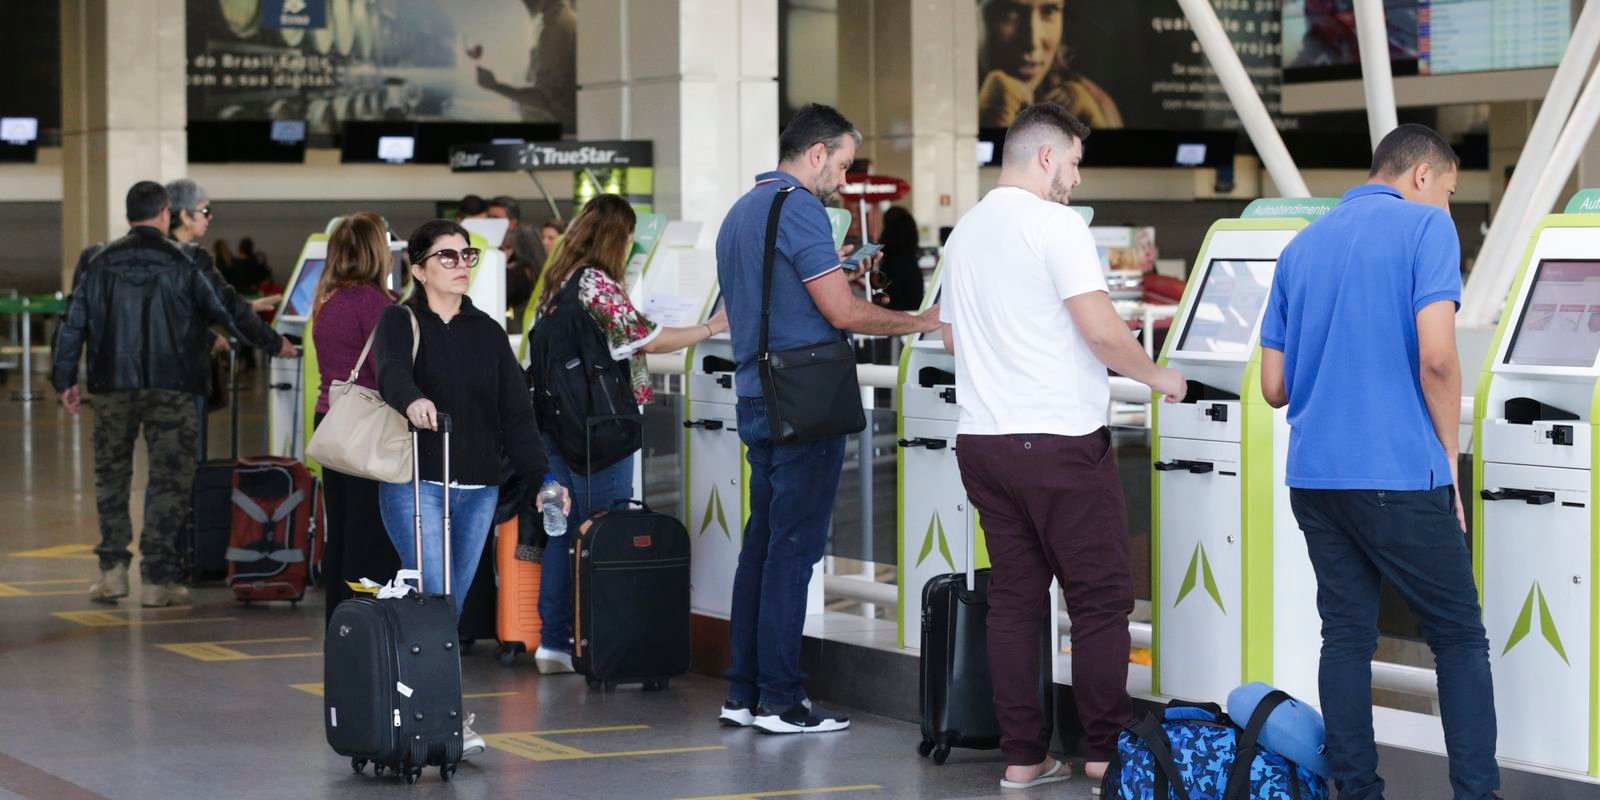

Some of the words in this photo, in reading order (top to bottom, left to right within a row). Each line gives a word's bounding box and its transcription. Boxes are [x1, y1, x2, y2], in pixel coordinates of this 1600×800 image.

[1233, 42, 1281, 58] rroja
[543, 147, 617, 164] TrueStar
[1253, 204, 1330, 216] Autoatendimento
